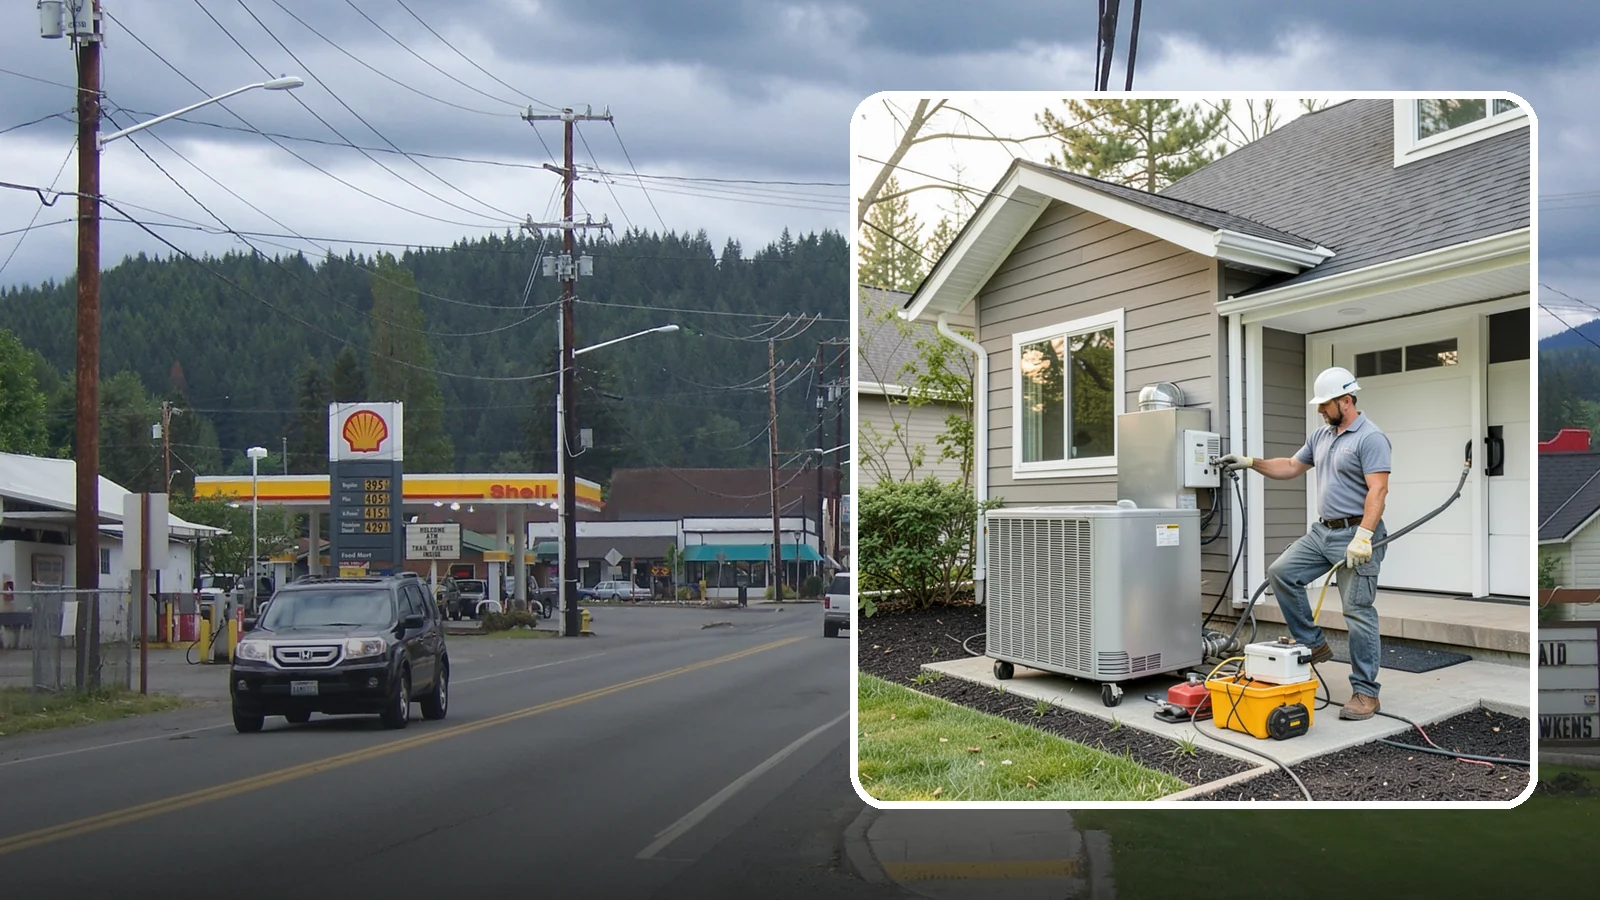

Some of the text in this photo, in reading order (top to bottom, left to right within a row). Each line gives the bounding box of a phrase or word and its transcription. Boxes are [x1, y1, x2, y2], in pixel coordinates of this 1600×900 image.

[365, 480, 384, 490] 395
[490, 484, 547, 499] Shell
[365, 494, 384, 504] 405
[365, 508, 384, 518] 415
[365, 522, 384, 533] 429
